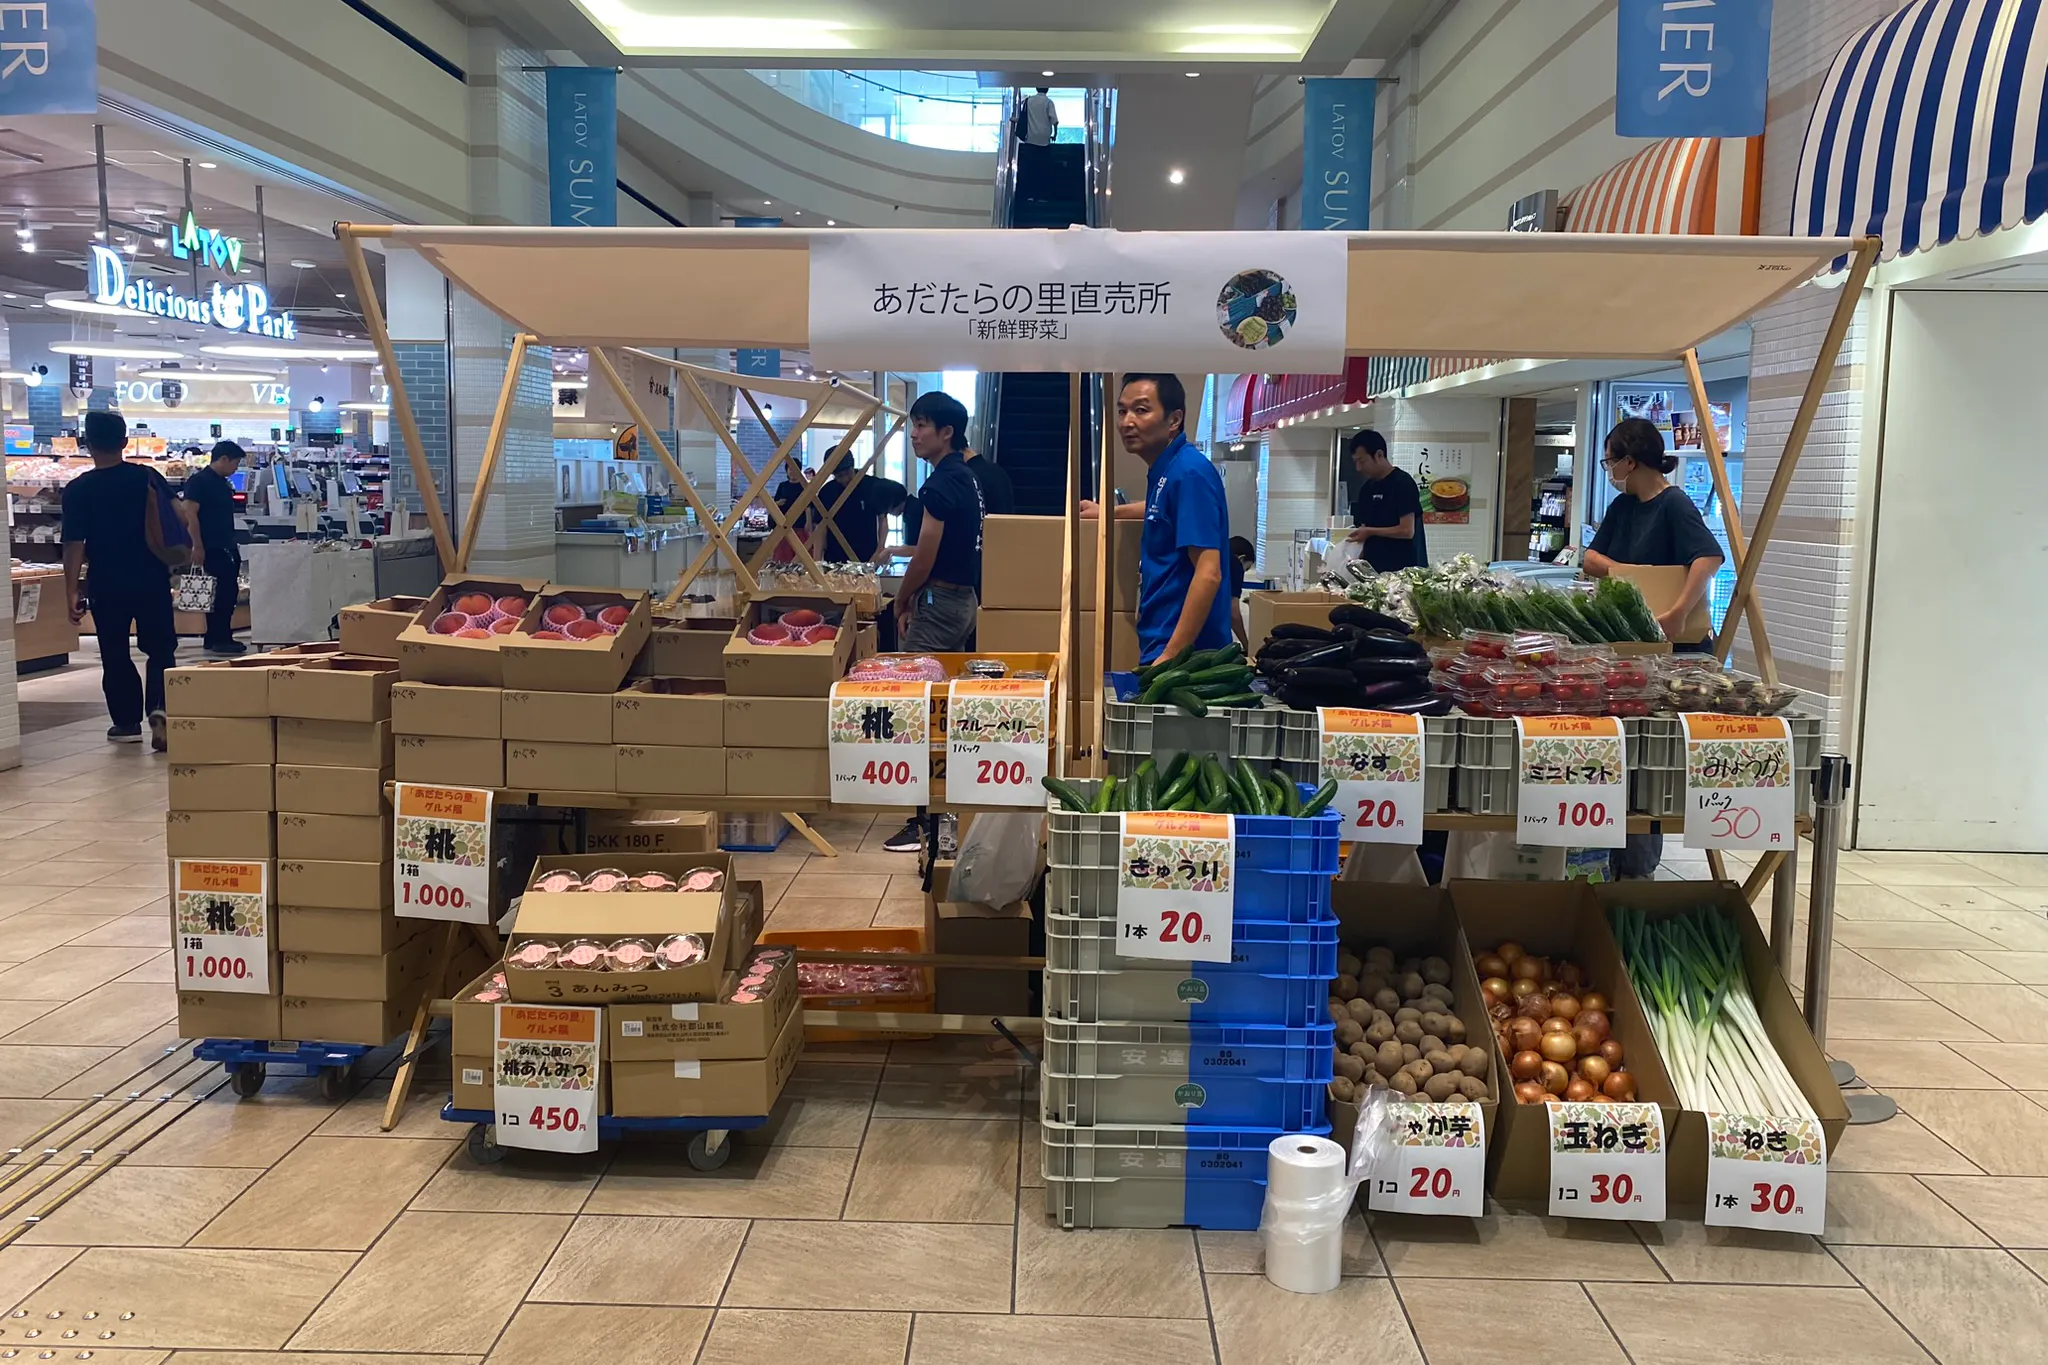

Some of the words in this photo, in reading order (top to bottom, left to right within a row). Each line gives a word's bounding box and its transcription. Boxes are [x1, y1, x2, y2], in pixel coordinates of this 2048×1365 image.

[573, 93, 587, 148] LATOV
[1331, 104, 1346, 159] LATOV
[171, 211, 242, 274] LATOV
[91, 245, 210, 325] Delicious
[246, 283, 297, 340] Park
[873, 281, 1171, 315] あだたらの里直売所
[967, 318, 1068, 340] 「新鮮野菜」
[391, 690, 417, 700] かぐや
[615, 700, 641, 710] かぐや
[861, 706, 894, 739] 桃
[956, 719, 1037, 733] ブルーベリー
[401, 738, 426, 747] かぐや
[513, 749, 538, 758] かぐや
[618, 748, 644, 758] かぐや
[862, 760, 918, 785] 400円
[976, 760, 1033, 785] 200円
[1350, 752, 1390, 772] なす
[1529, 765, 1613, 781] ミニトマト
[1703, 748, 1784, 779] みょうが
[410, 787, 478, 804] 「あだたらの里」
[424, 802, 463, 815] グルメ展
[1356, 799, 1404, 828] 20円
[1558, 802, 1614, 827] 100円
[425, 827, 456, 860] 桃
[588, 834, 619, 848] SKK
[625, 834, 650, 847] 180
[656, 834, 665, 846] F
[280, 862, 304, 873] かぐや
[400, 863, 419, 877] 1箱
[1130, 857, 1218, 881] きゅうり
[203, 877, 239, 887] グルメ展
[206, 900, 236, 932] 桃
[1124, 924, 1148, 939] 1本
[1159, 910, 1212, 944] 20円
[184, 937, 203, 949] 1箱
[572, 983, 649, 994] あんみつ
[510, 1009, 586, 1024] 「あだたらの里」
[526, 1024, 570, 1036] グルメ展
[503, 1059, 588, 1078] 桃あんみつ
[1203, 1058, 1247, 1067] 0302041
[502, 1112, 520, 1126] 1コ
[528, 1106, 587, 1132] 450円
[1563, 1121, 1648, 1150] 玉ねぎ
[1743, 1128, 1788, 1152] ねぎ
[1200, 1160, 1244, 1169] 0302041
[1378, 1180, 1398, 1194] 1コ
[1409, 1166, 1460, 1199] 20円
[1558, 1187, 1579, 1200] 1コ
[1590, 1173, 1642, 1205] 30円
[1715, 1194, 1739, 1209] 1本
[1750, 1182, 1804, 1215] 30円
